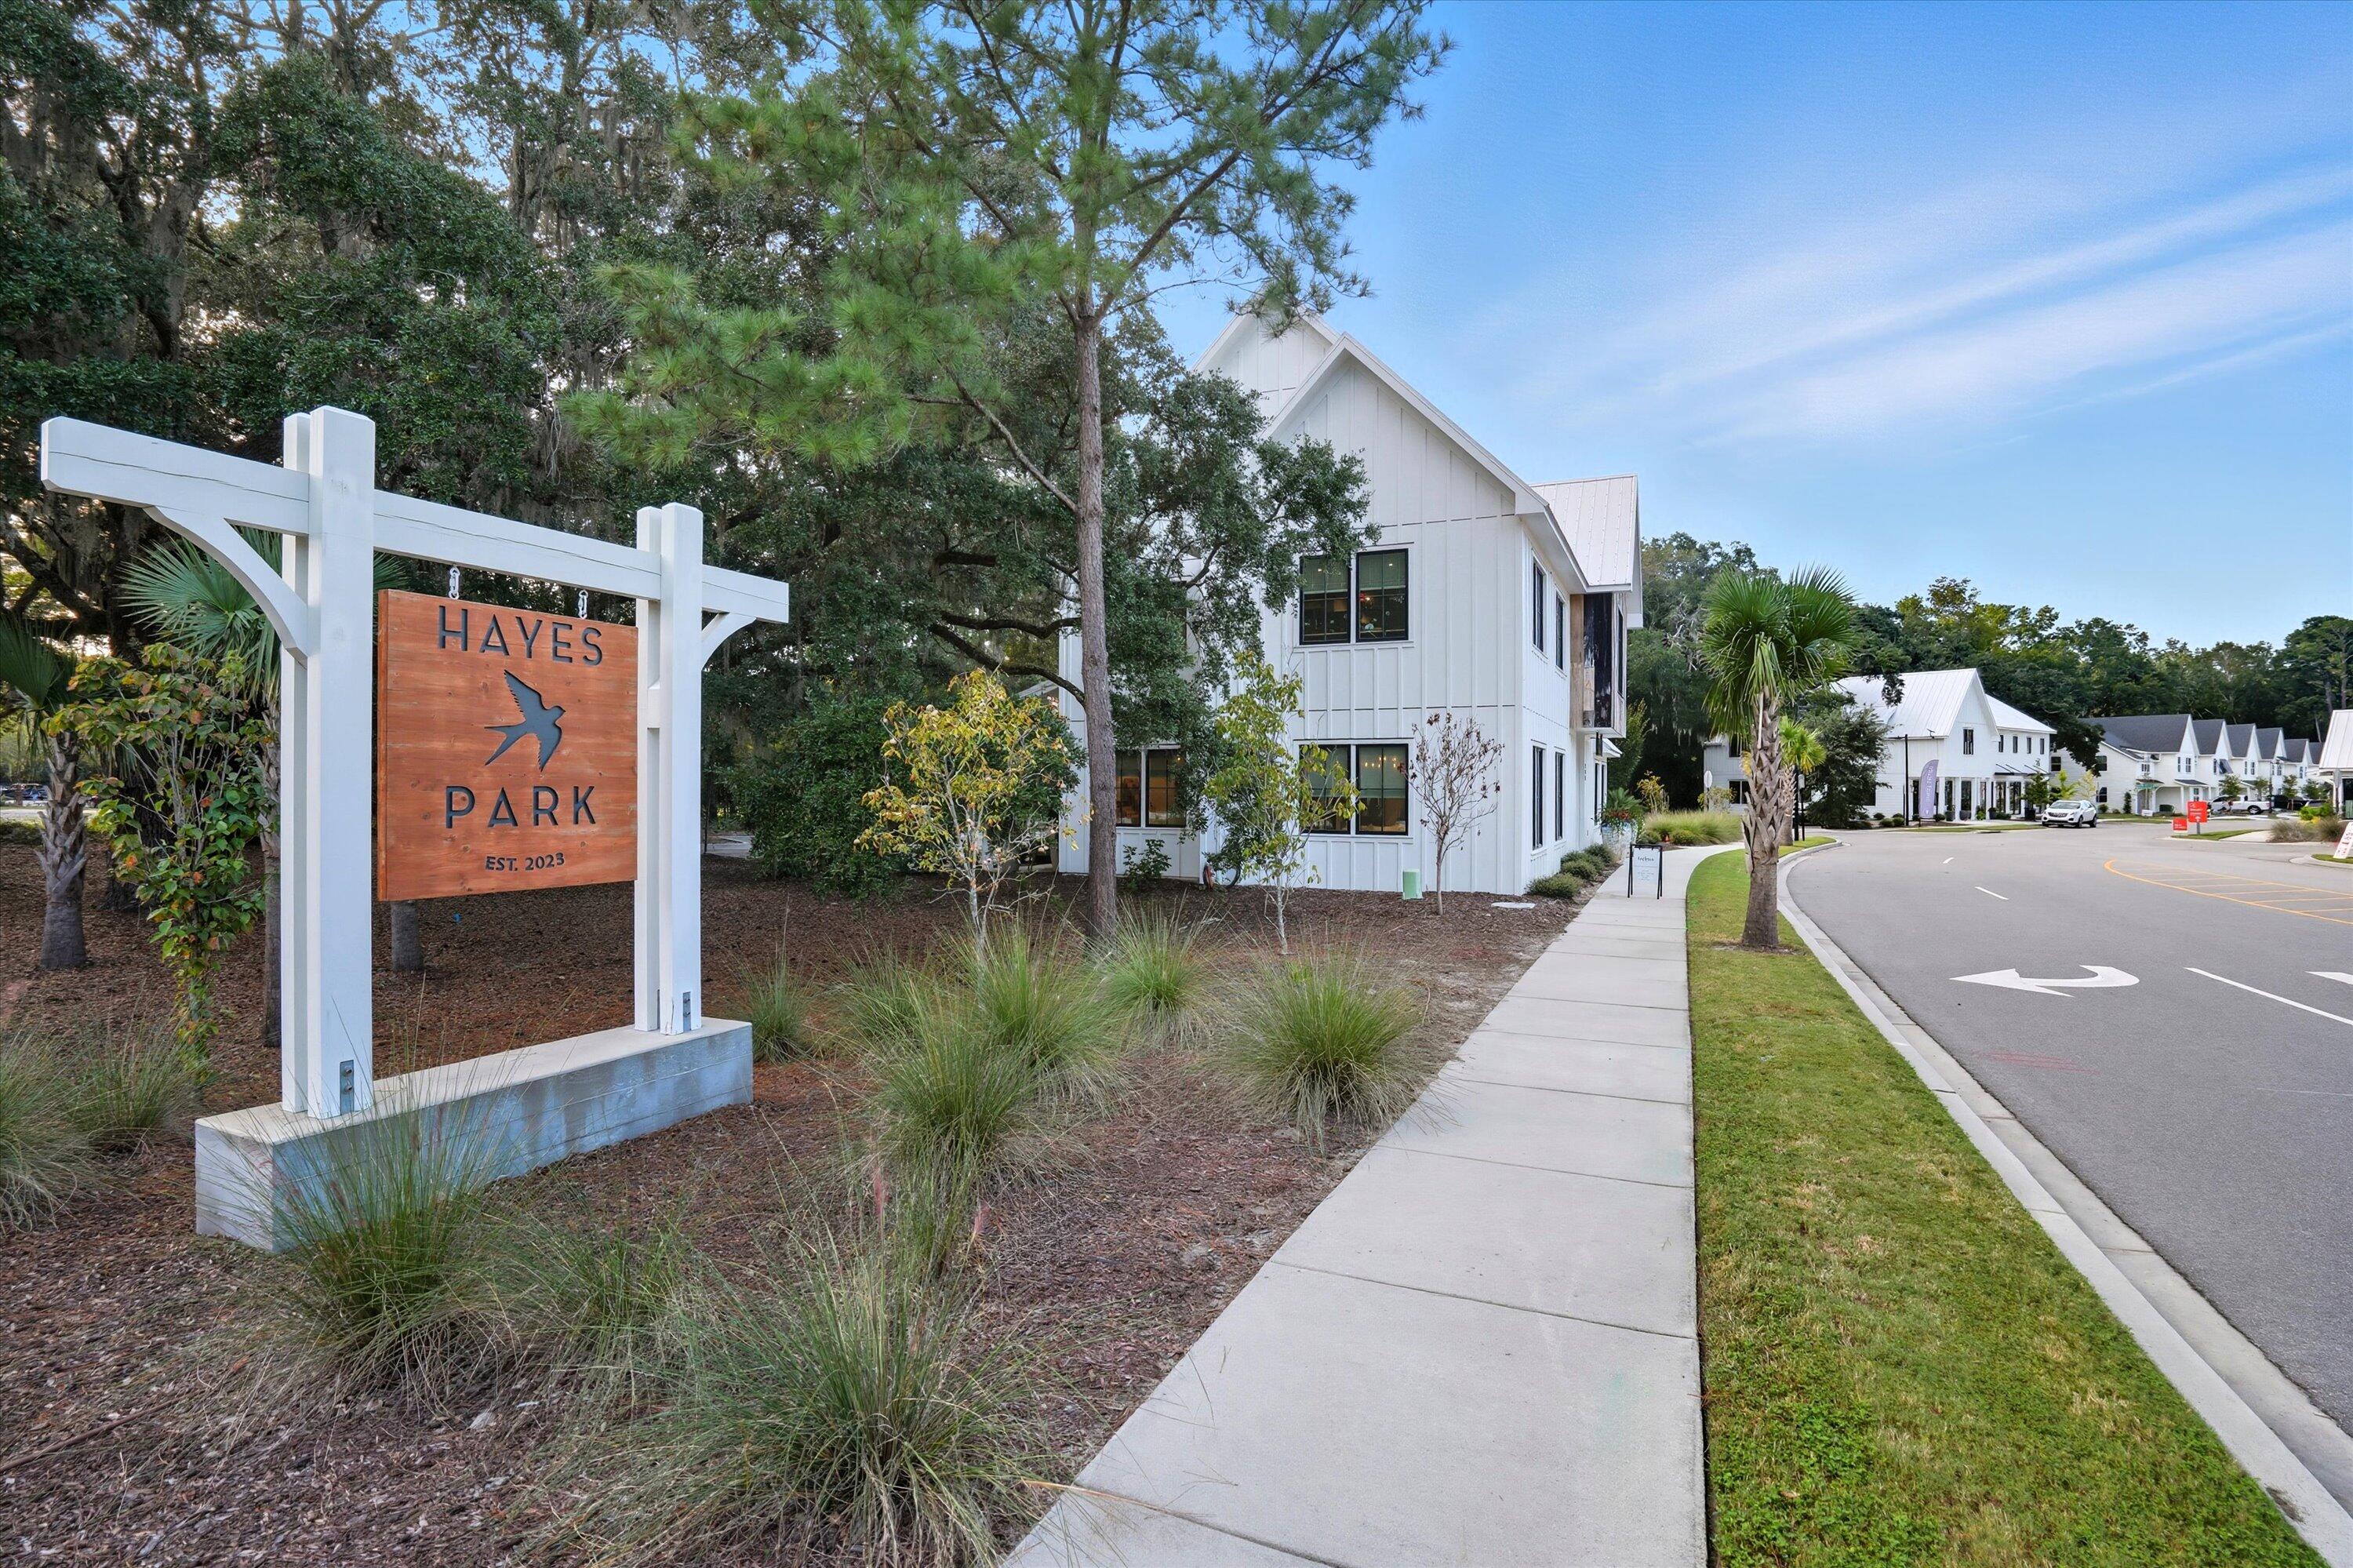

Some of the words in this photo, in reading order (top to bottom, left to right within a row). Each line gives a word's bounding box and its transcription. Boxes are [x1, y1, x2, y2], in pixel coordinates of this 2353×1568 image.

[438, 606, 603, 666] HAYES
[446, 786, 596, 829] PARK
[486, 857, 518, 871] EST.
[526, 852, 565, 871] 2023
